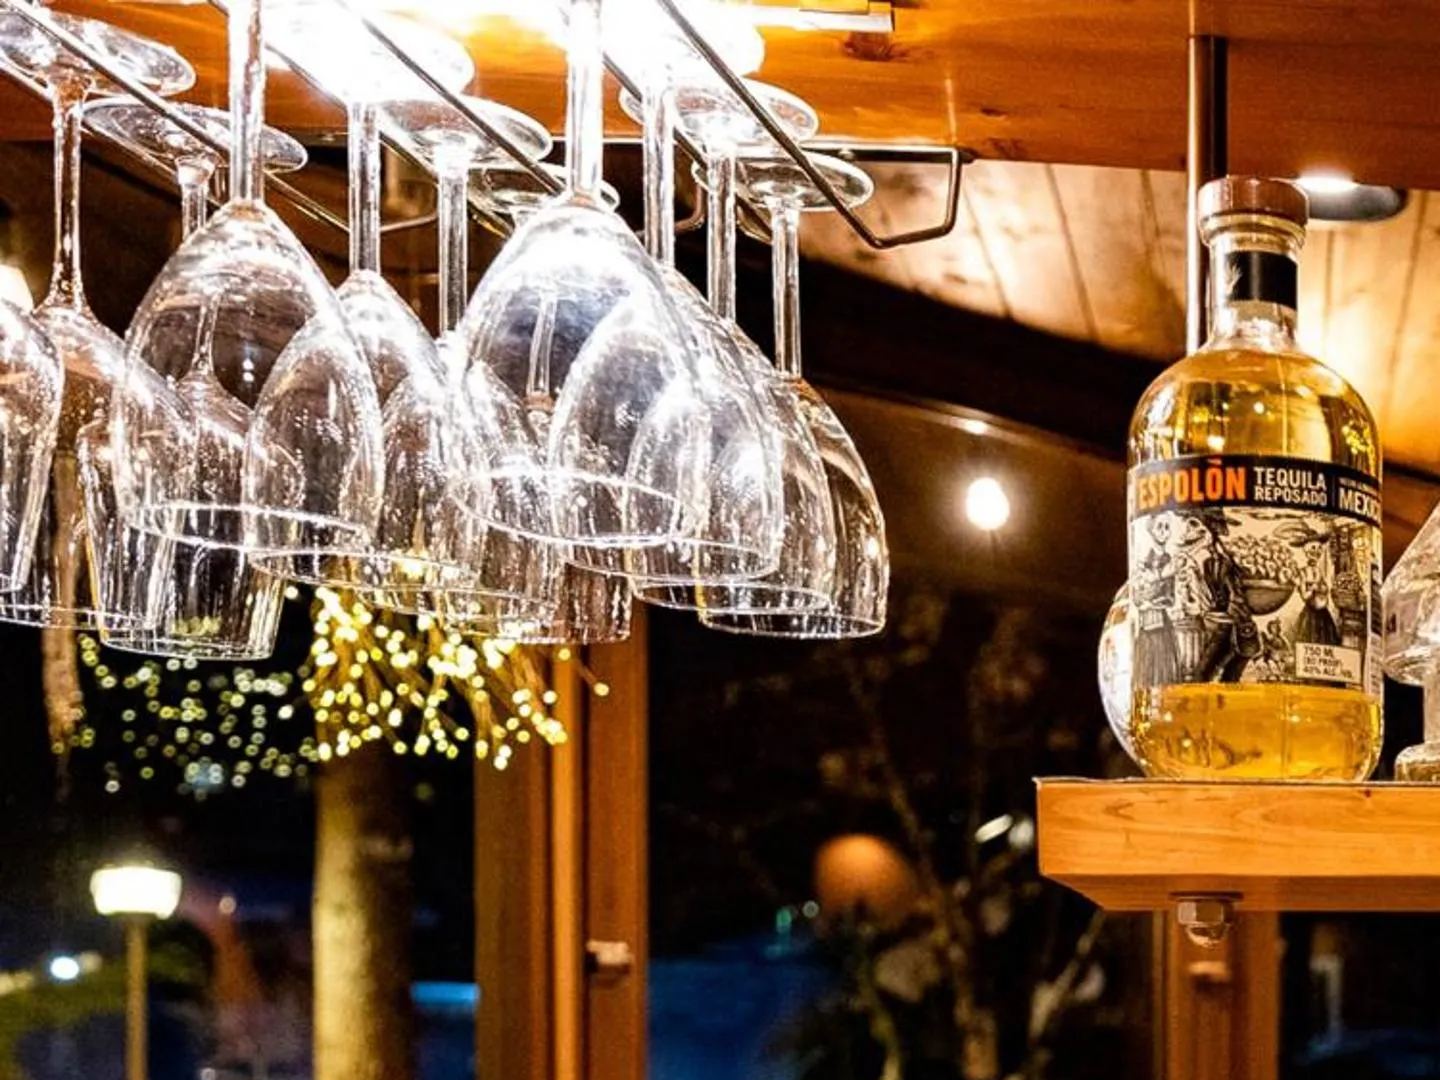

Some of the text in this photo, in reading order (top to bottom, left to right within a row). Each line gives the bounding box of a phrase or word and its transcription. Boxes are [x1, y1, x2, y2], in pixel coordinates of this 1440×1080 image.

[1138, 457, 1247, 509] ESPOLÓN
[1254, 466, 1326, 490] TEQUILA
[1254, 486, 1328, 507] REPOSADO
